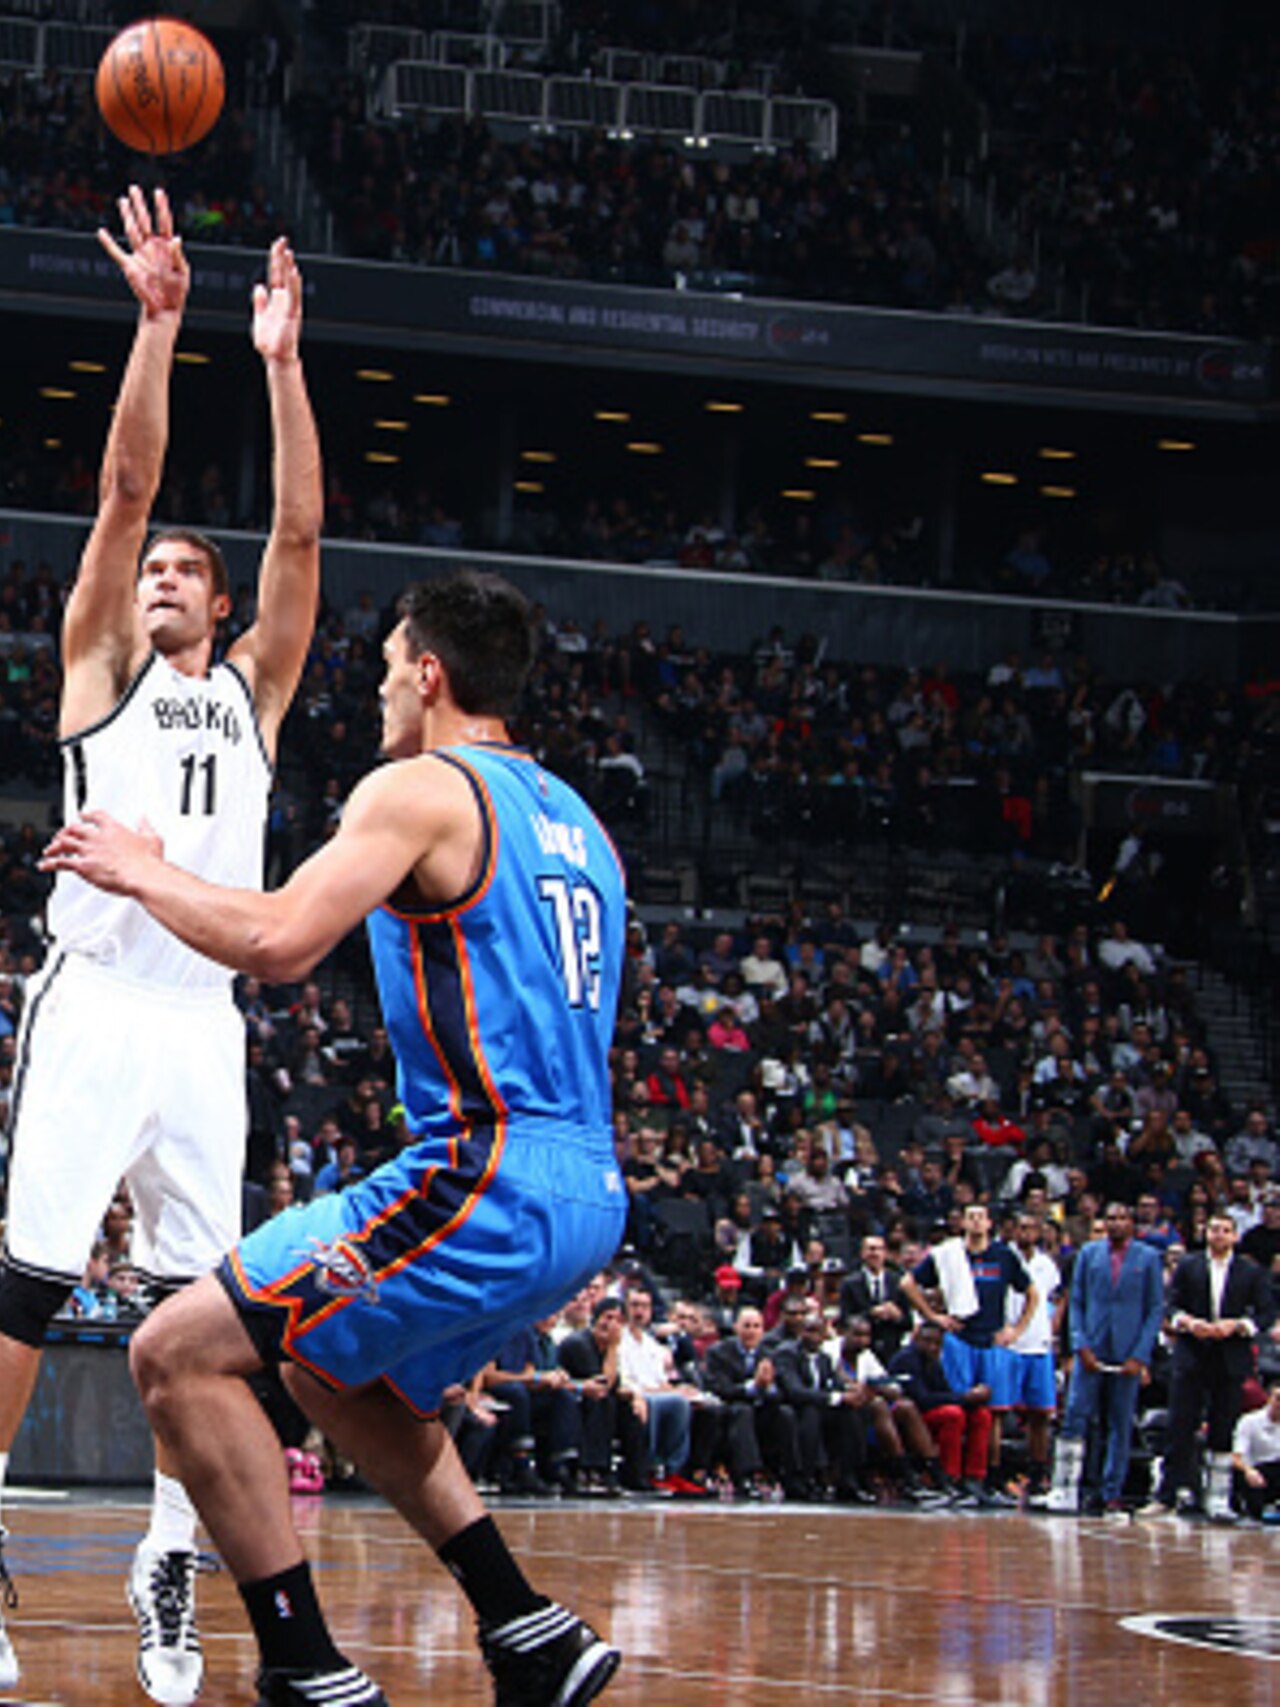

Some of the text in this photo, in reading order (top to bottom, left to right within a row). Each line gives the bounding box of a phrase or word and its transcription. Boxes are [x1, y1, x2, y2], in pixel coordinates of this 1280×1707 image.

[470, 296, 564, 324] COMMERCIAL
[568, 305, 596, 326] AND
[602, 308, 687, 336] RESIDENTIAL
[691, 318, 759, 341] SECURITY
[180, 754, 216, 815] 11
[535, 873, 605, 1010] 12
